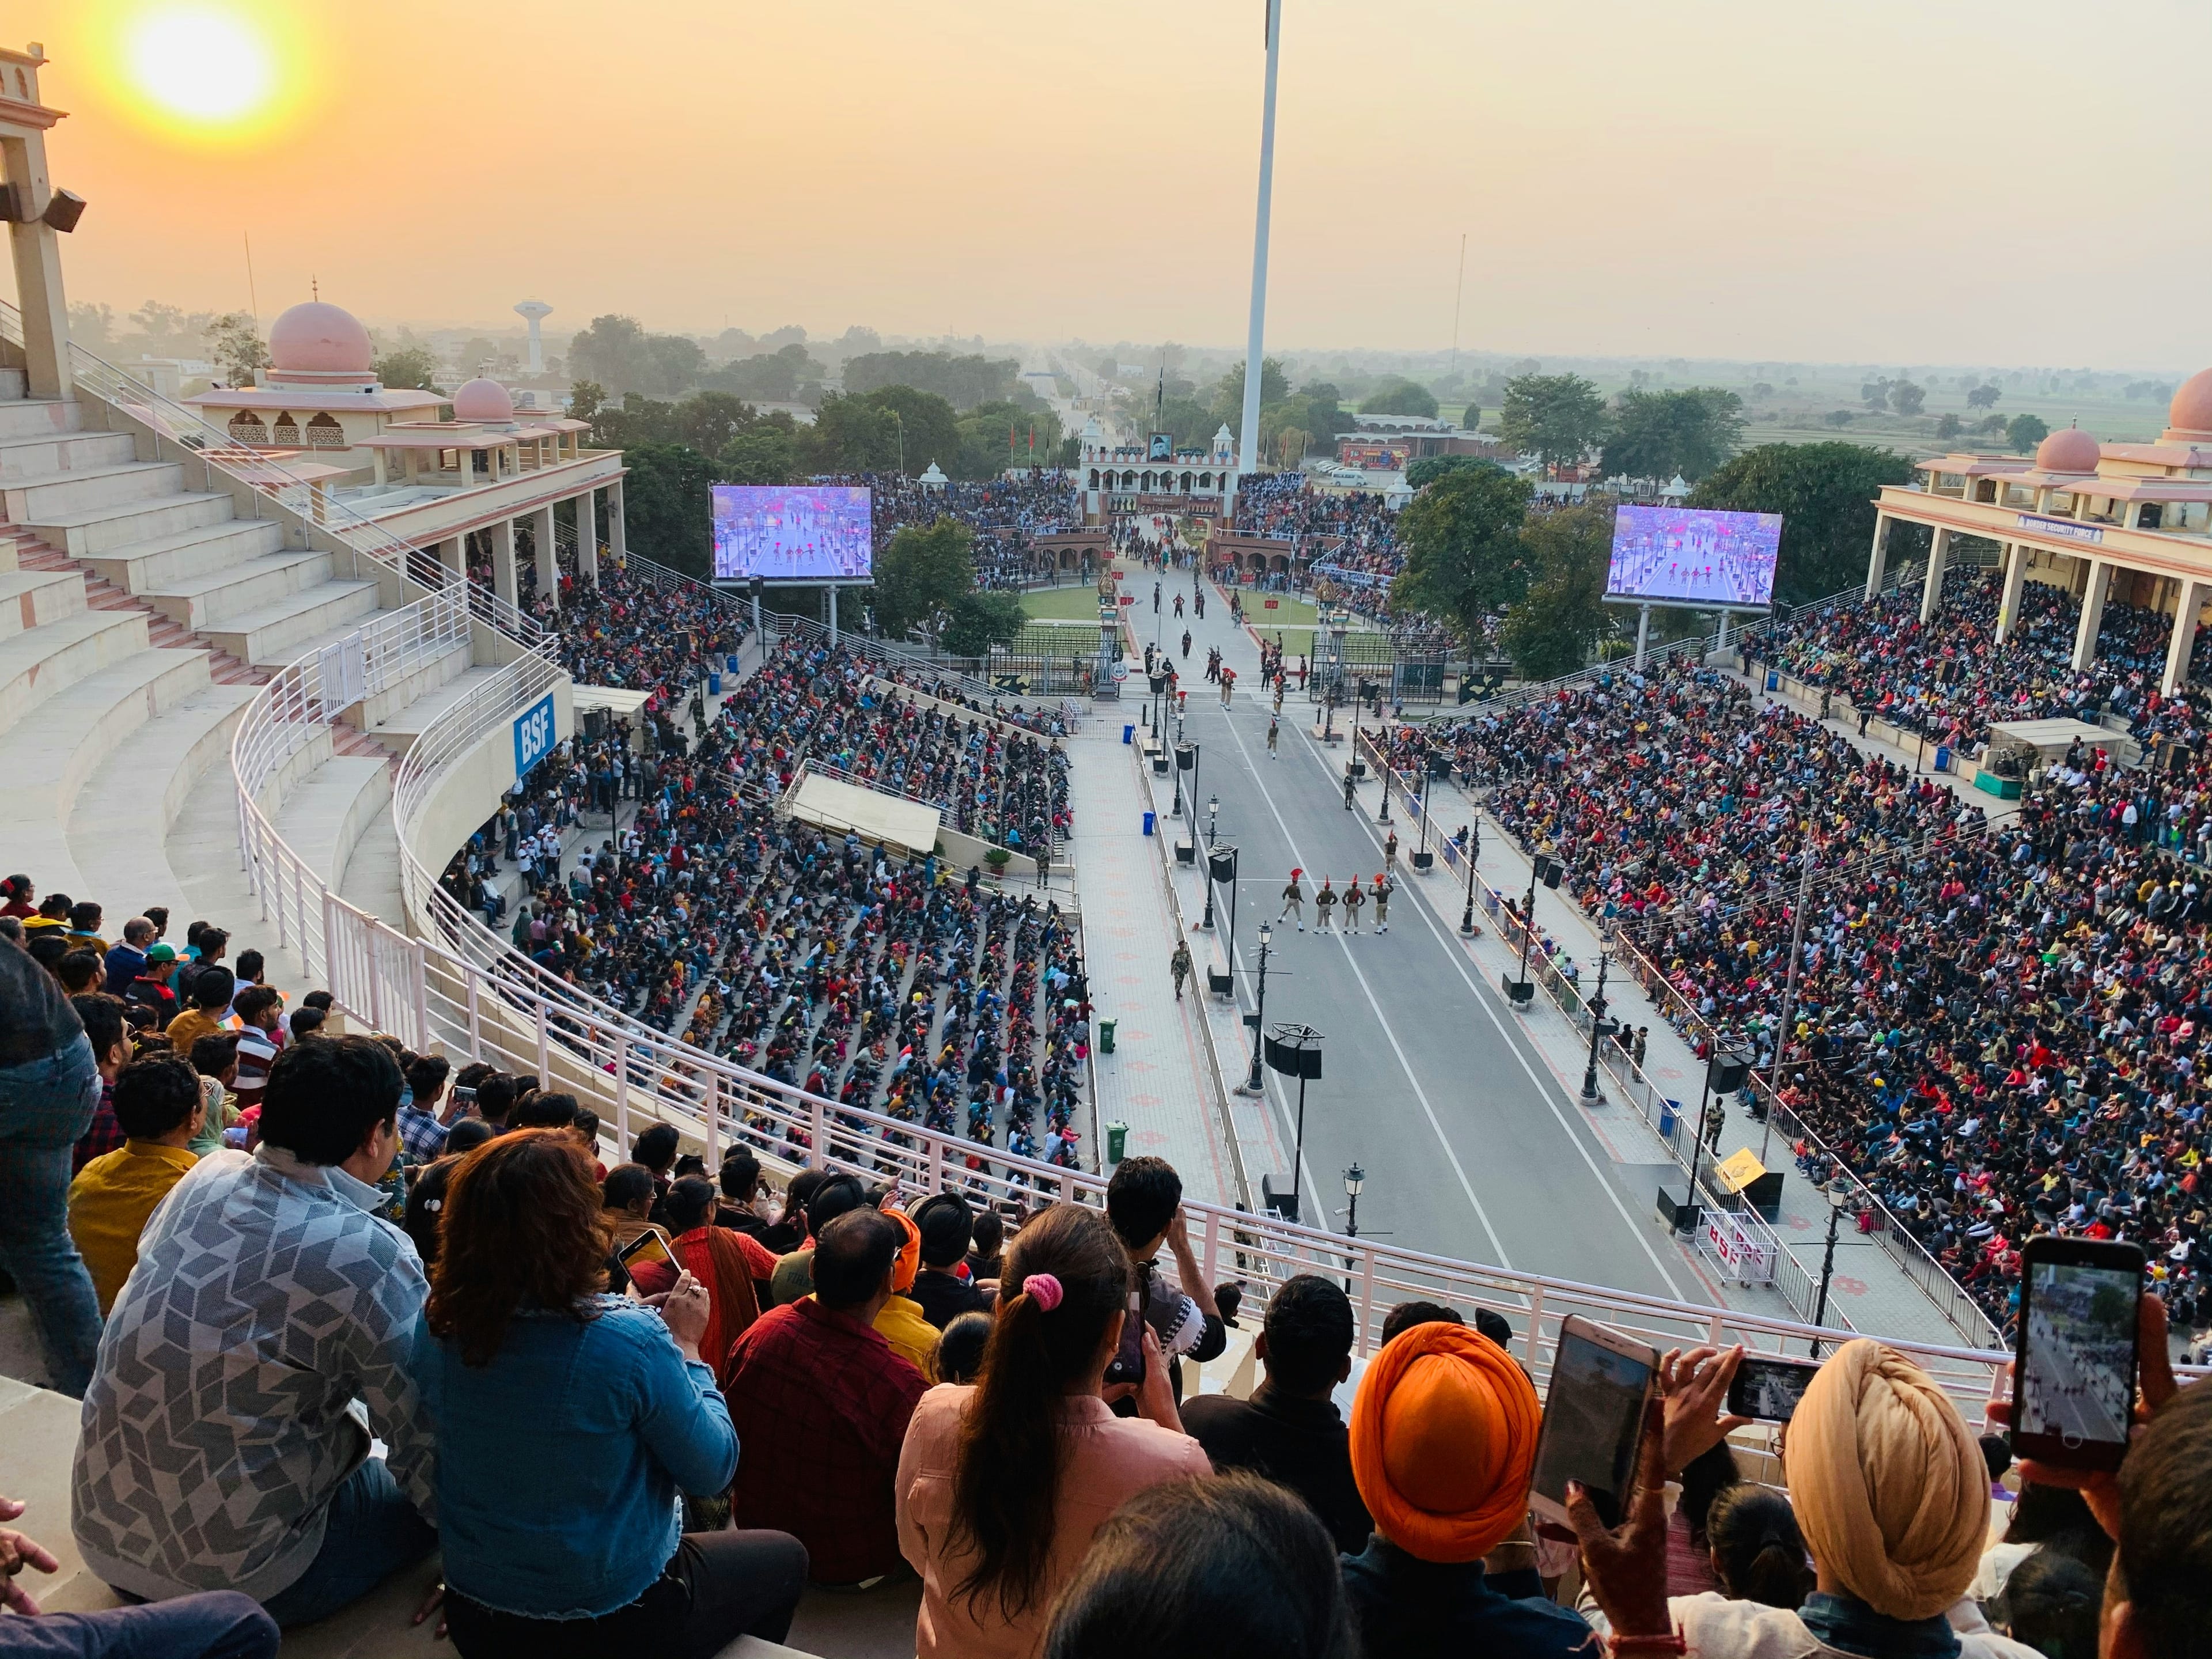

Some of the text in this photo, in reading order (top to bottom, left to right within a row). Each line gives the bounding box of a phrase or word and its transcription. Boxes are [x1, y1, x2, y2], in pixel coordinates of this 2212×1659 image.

[2026, 518, 2092, 539] BORDER SECURITY FORCE
[521, 704, 548, 765] BSF
